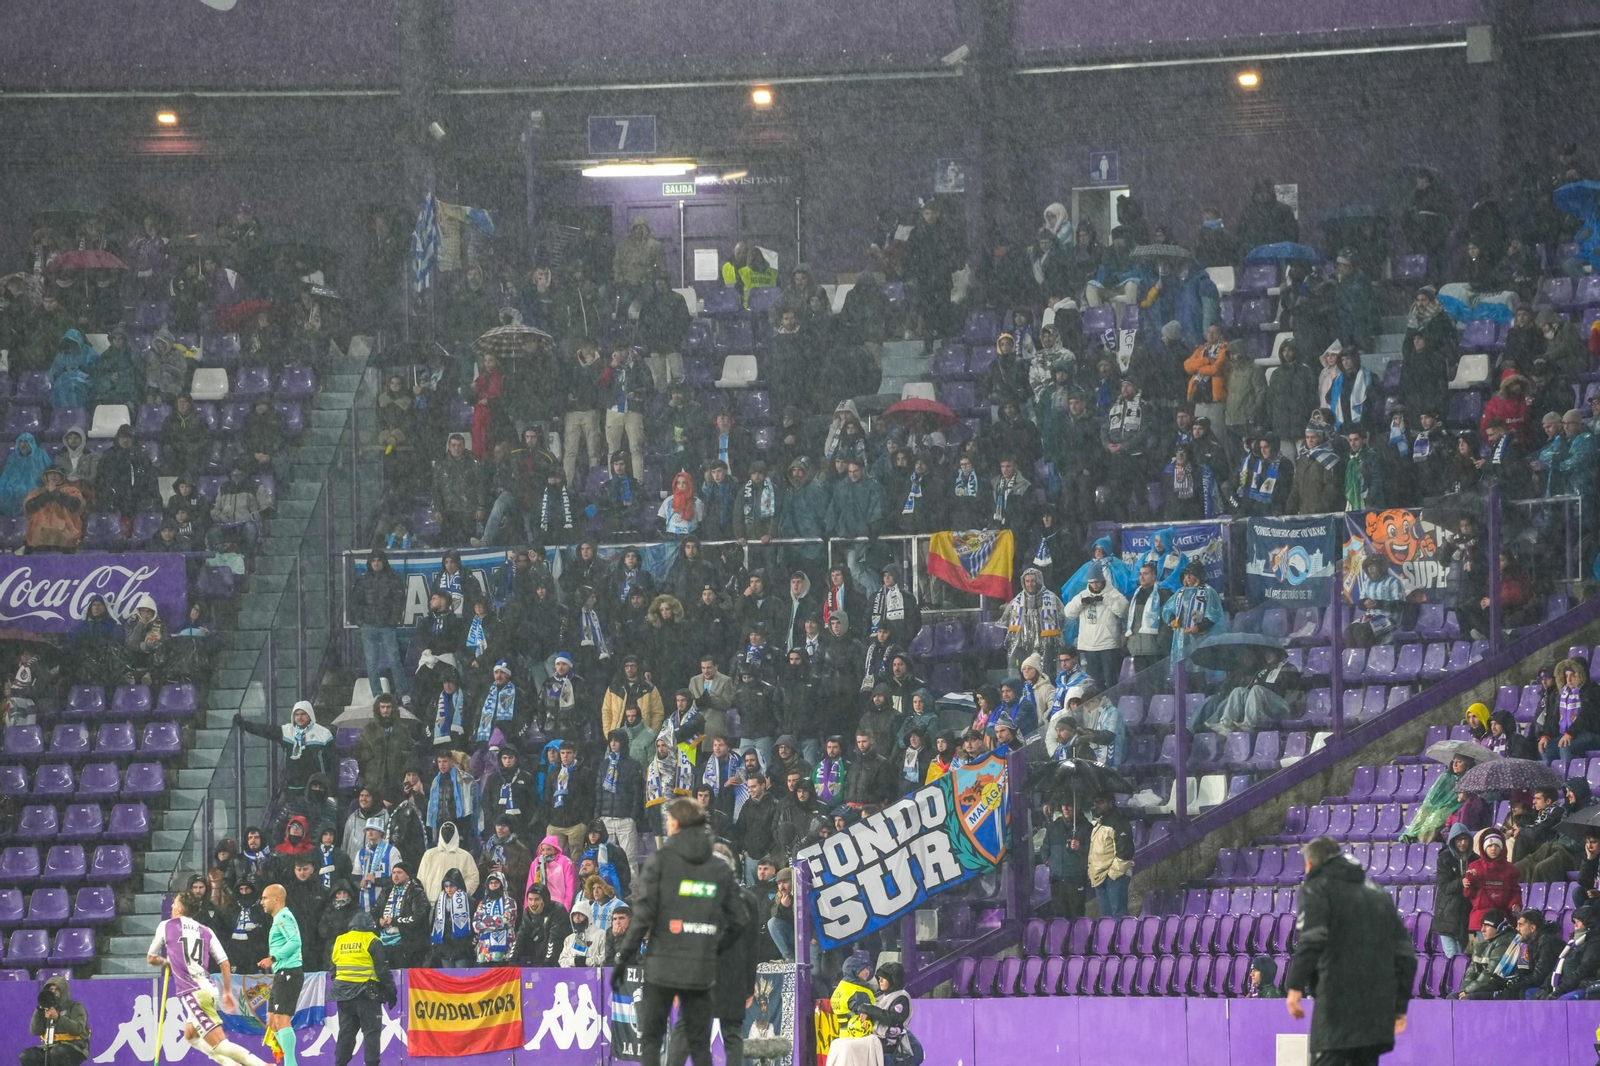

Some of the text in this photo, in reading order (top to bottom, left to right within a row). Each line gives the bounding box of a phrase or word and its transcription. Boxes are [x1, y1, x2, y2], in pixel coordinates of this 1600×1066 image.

[615, 120, 629, 149] 7
[665, 184, 693, 194] SALIDA
[1403, 560, 1450, 589] SUPE
[0, 565, 160, 625] Coca-Cola
[797, 785, 947, 889] FONDO
[817, 829, 962, 940] SUR
[178, 936, 205, 967] 14
[627, 968, 639, 982] EL
[251, 989, 271, 1005] MALAG
[415, 993, 516, 1021] GUADALMAR
[622, 1042, 634, 1055] LA
